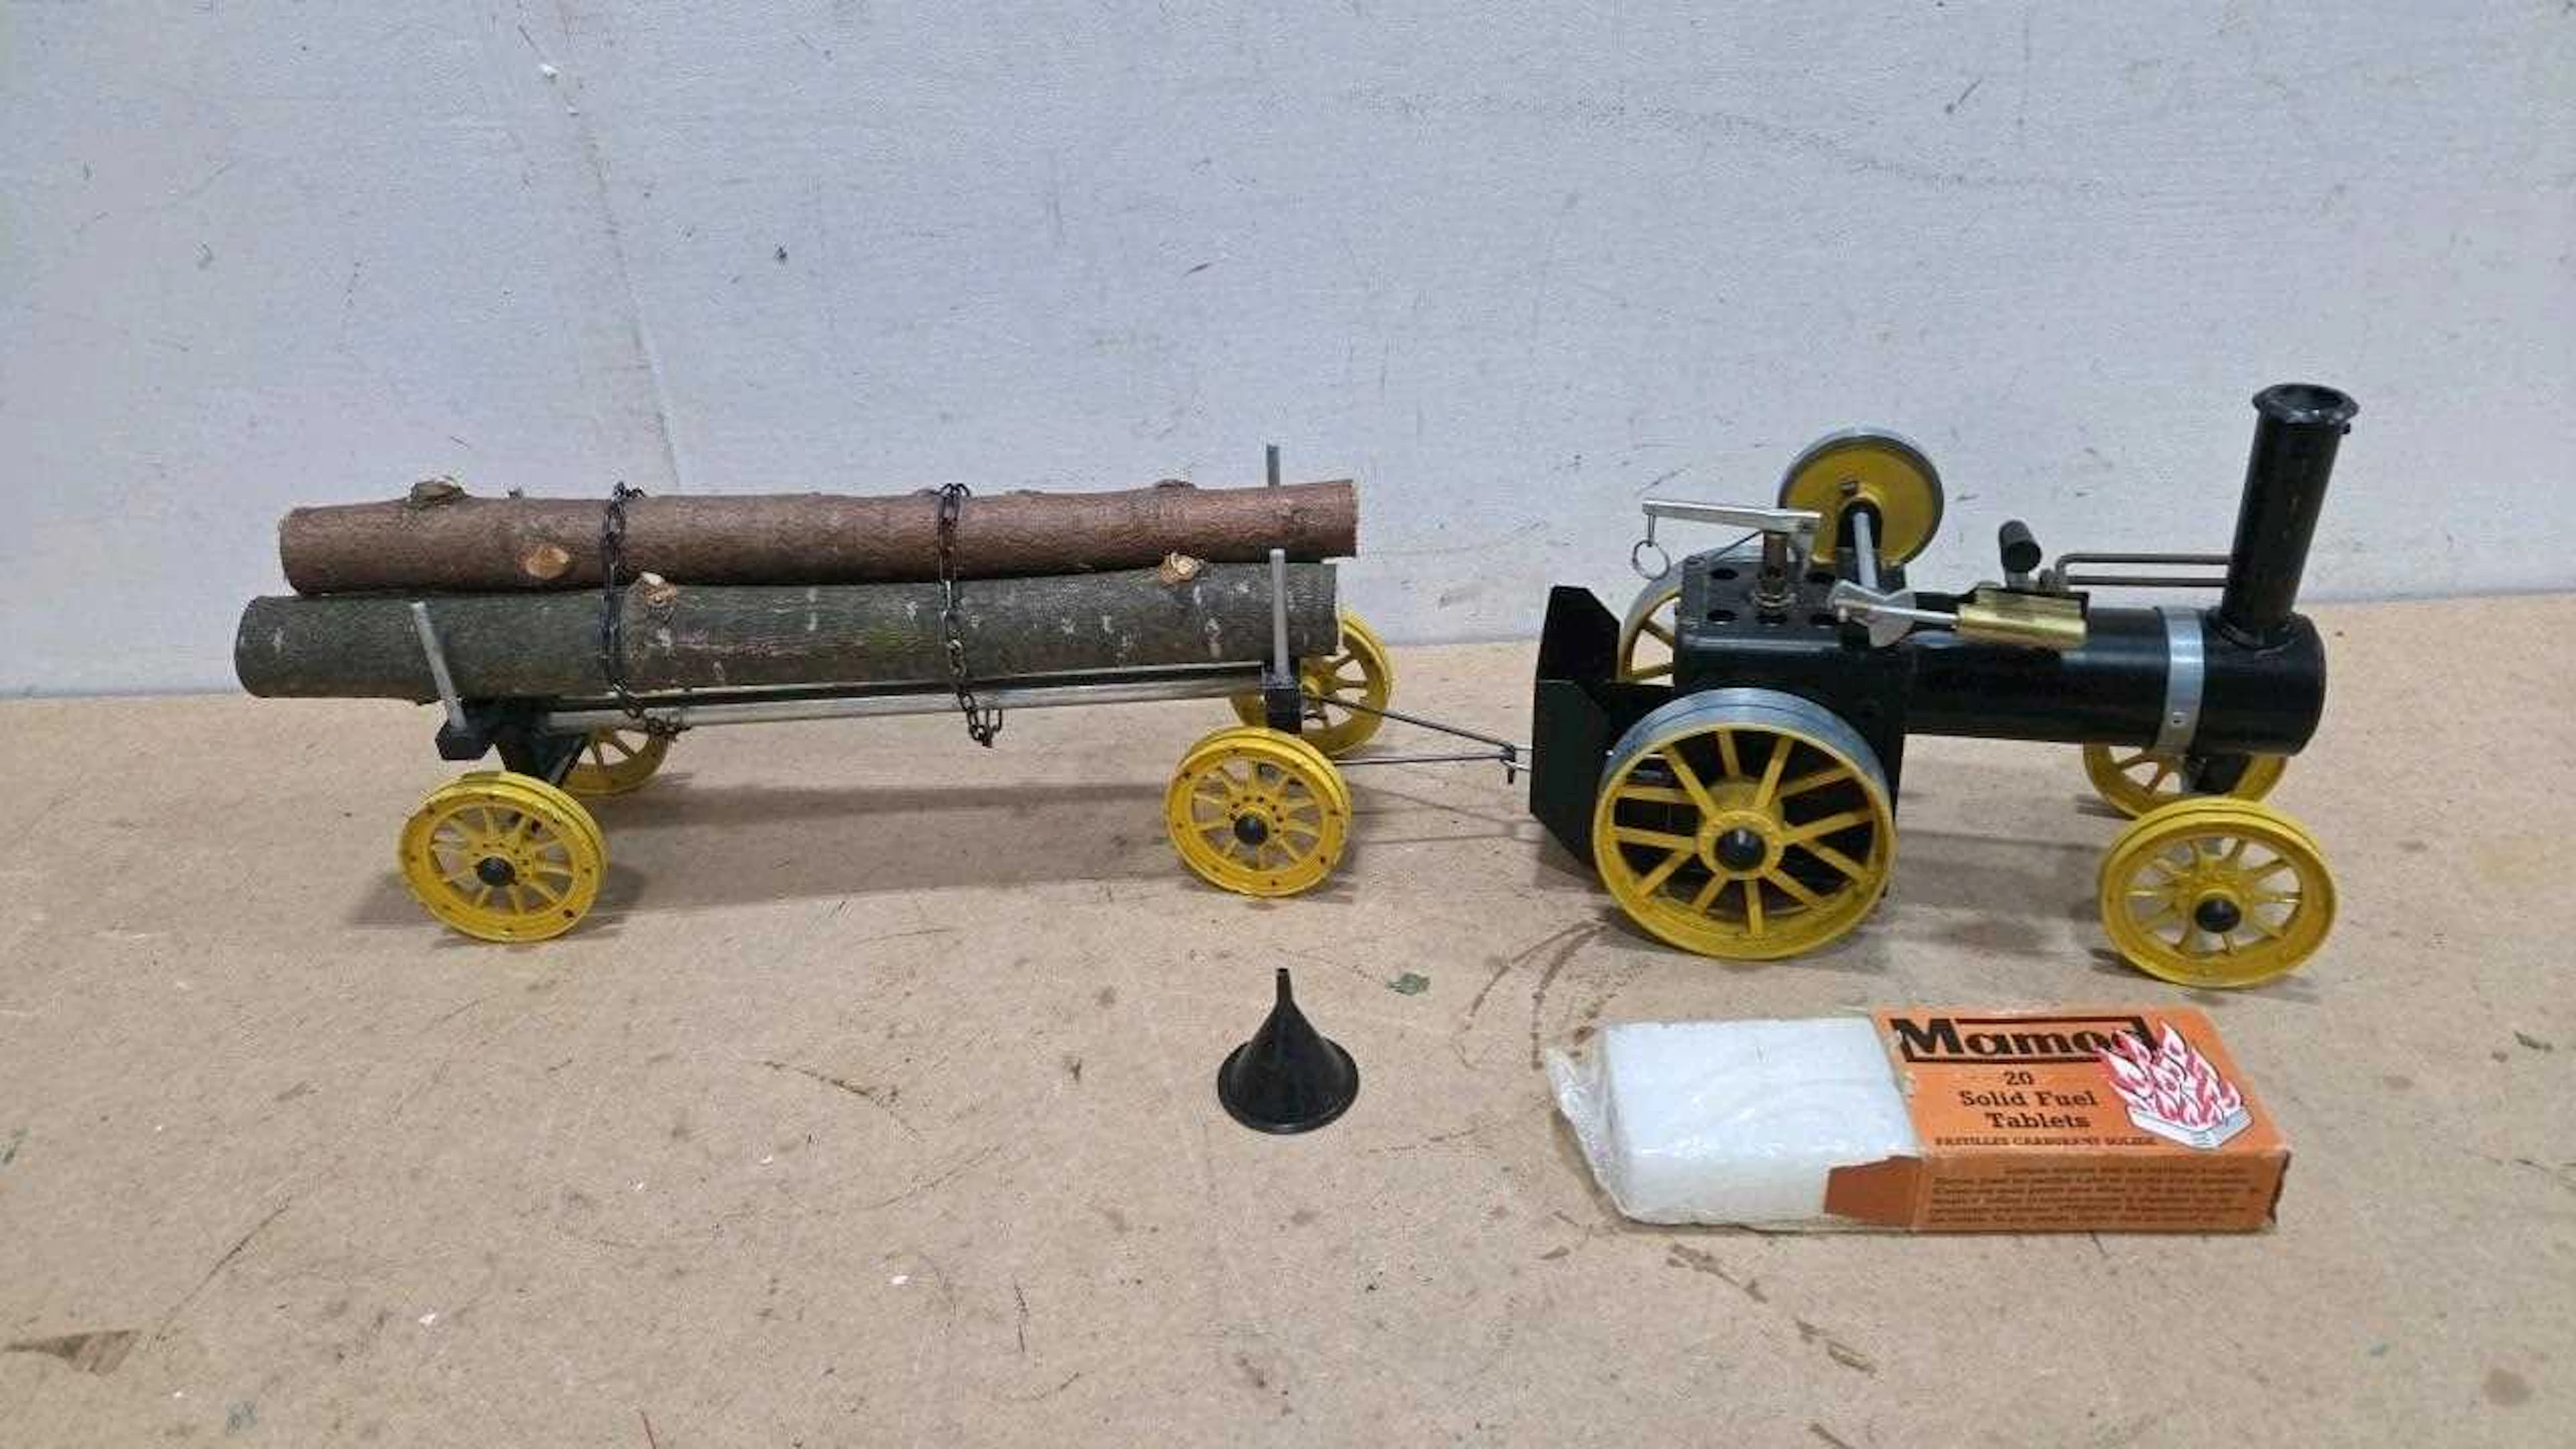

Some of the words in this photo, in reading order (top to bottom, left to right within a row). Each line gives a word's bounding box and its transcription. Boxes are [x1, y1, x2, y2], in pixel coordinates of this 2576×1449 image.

[2002, 1071, 2034, 1086] 20
[1959, 1090, 2027, 1108] Solid
[2035, 1090, 2098, 1108] Fuel
[1984, 1112, 2091, 1129] Tablets
